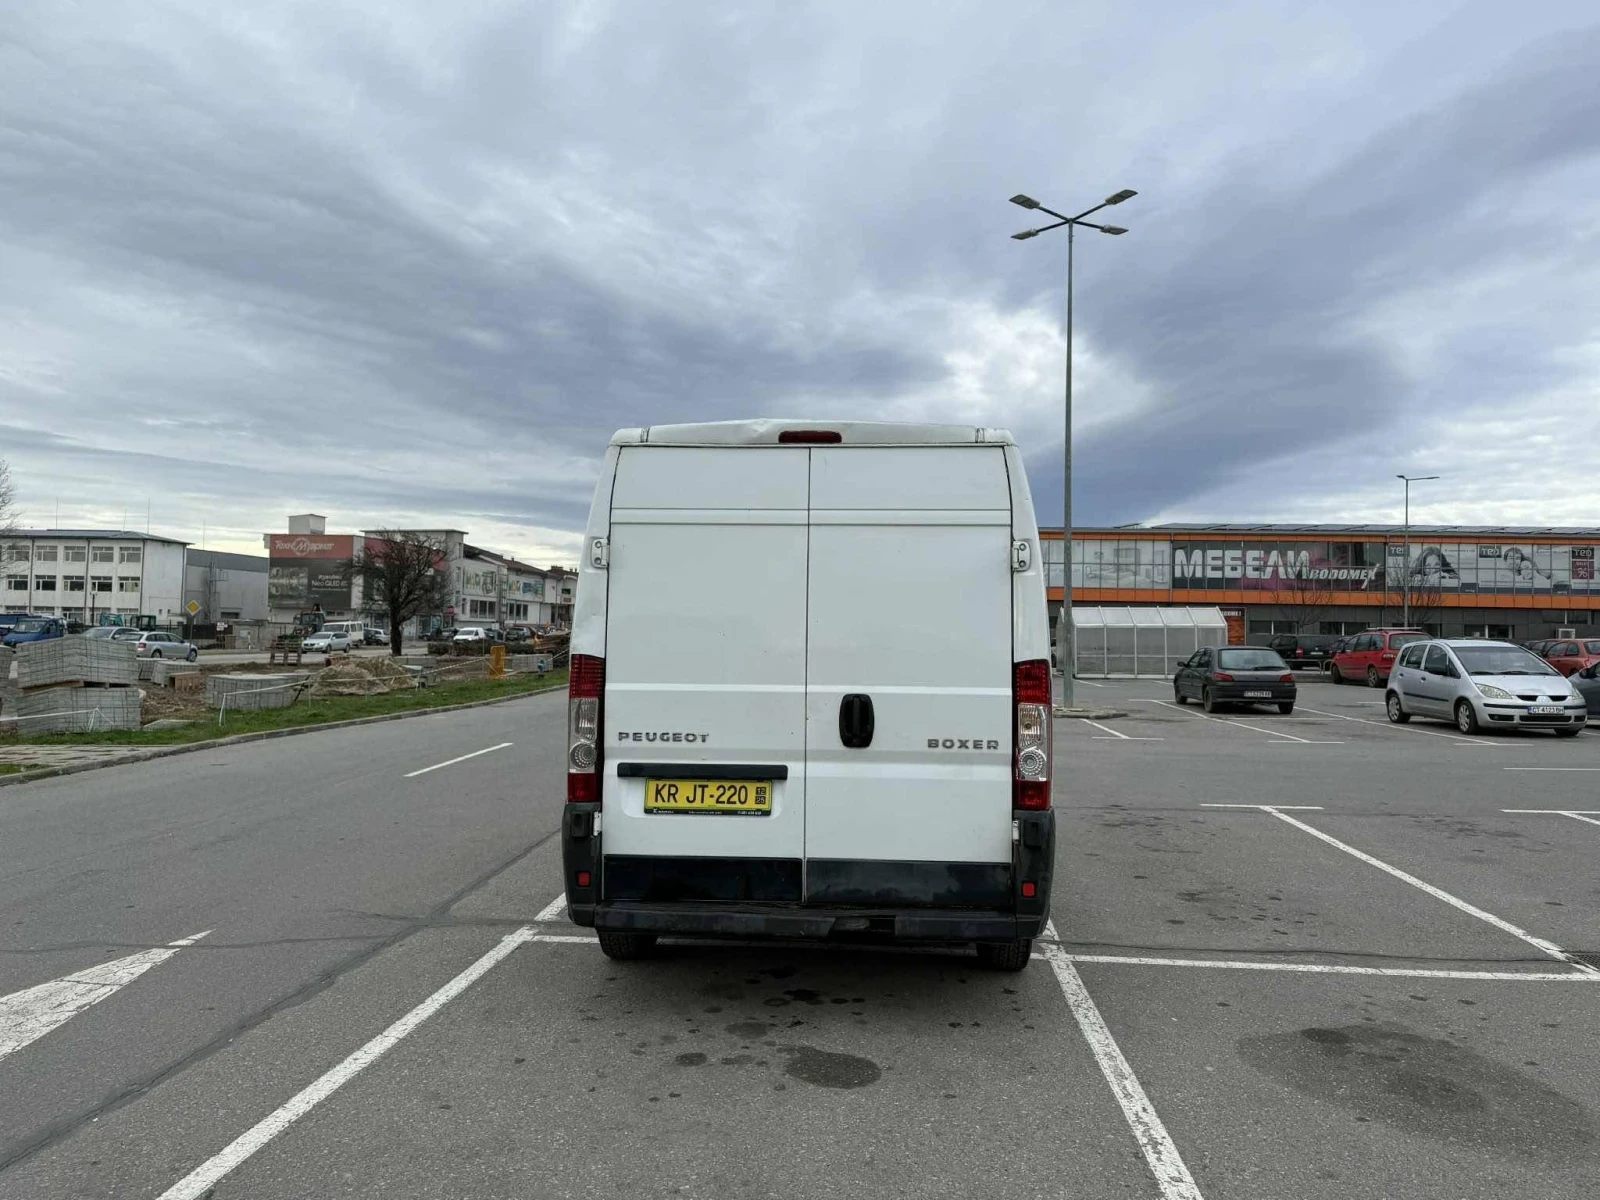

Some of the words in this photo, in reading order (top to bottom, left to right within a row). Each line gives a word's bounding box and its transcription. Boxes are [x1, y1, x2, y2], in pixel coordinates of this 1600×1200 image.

[1174, 549, 1310, 579] МЕБЕЛИ
[618, 732, 709, 743] PEUGEOT
[927, 738, 999, 750] BOXER
[654, 783, 679, 803] KR
[686, 784, 748, 805] JT-220
[756, 787, 766, 795] 12
